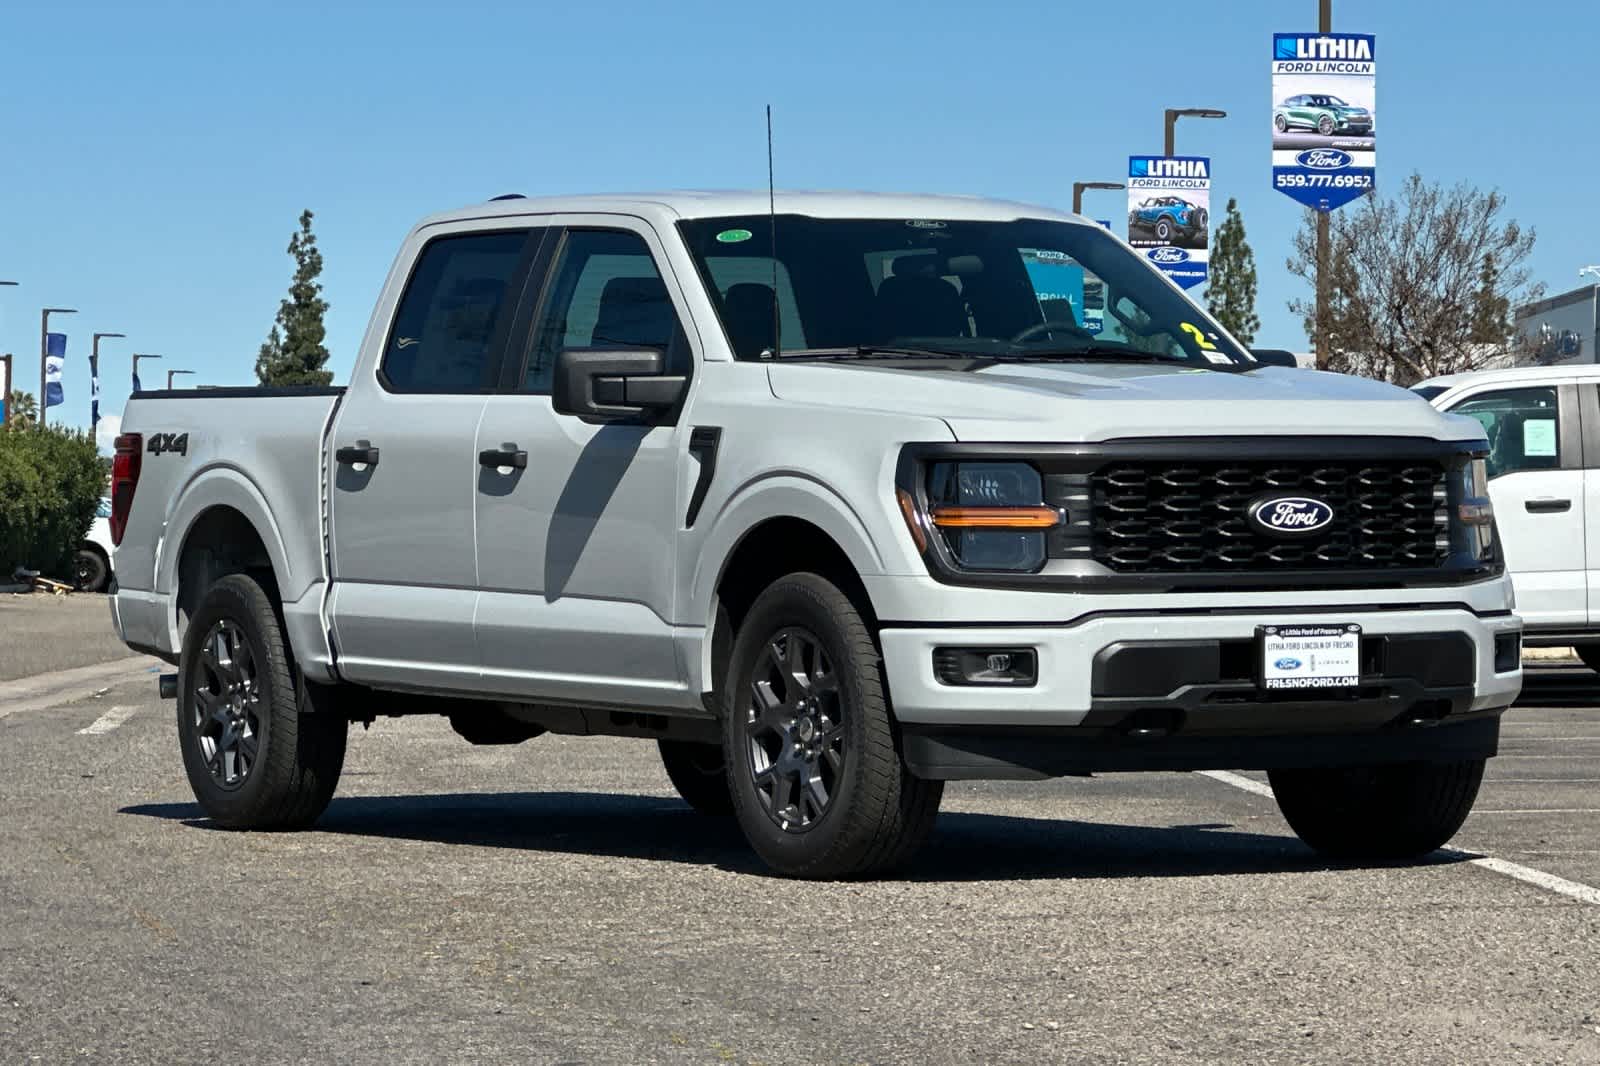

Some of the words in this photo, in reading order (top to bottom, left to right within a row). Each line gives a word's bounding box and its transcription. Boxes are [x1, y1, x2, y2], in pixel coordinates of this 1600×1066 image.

[1297, 38, 1371, 59] LITHIA
[1277, 62, 1314, 73] FORD
[1315, 63, 1371, 73] LINCOLN
[1306, 150, 1343, 166] Ford
[1147, 160, 1208, 177] LITHIA
[1131, 179, 1161, 187] FORD
[1162, 179, 1207, 188] LINCOLN
[1277, 174, 1372, 188] 559.777.6952
[1154, 248, 1183, 261] Ford
[1180, 322, 1217, 350] 2
[1271, 502, 1319, 526] Ford
[1301, 627, 1314, 636] Ford
[1267, 642, 1285, 650] LITHIA
[1286, 642, 1300, 650] FORD
[1302, 641, 1324, 650] LINCOLN
[1325, 641, 1332, 649] OF
[1333, 640, 1354, 649] FRESNO
[1266, 676, 1359, 688] FRESNOFORD.COM
